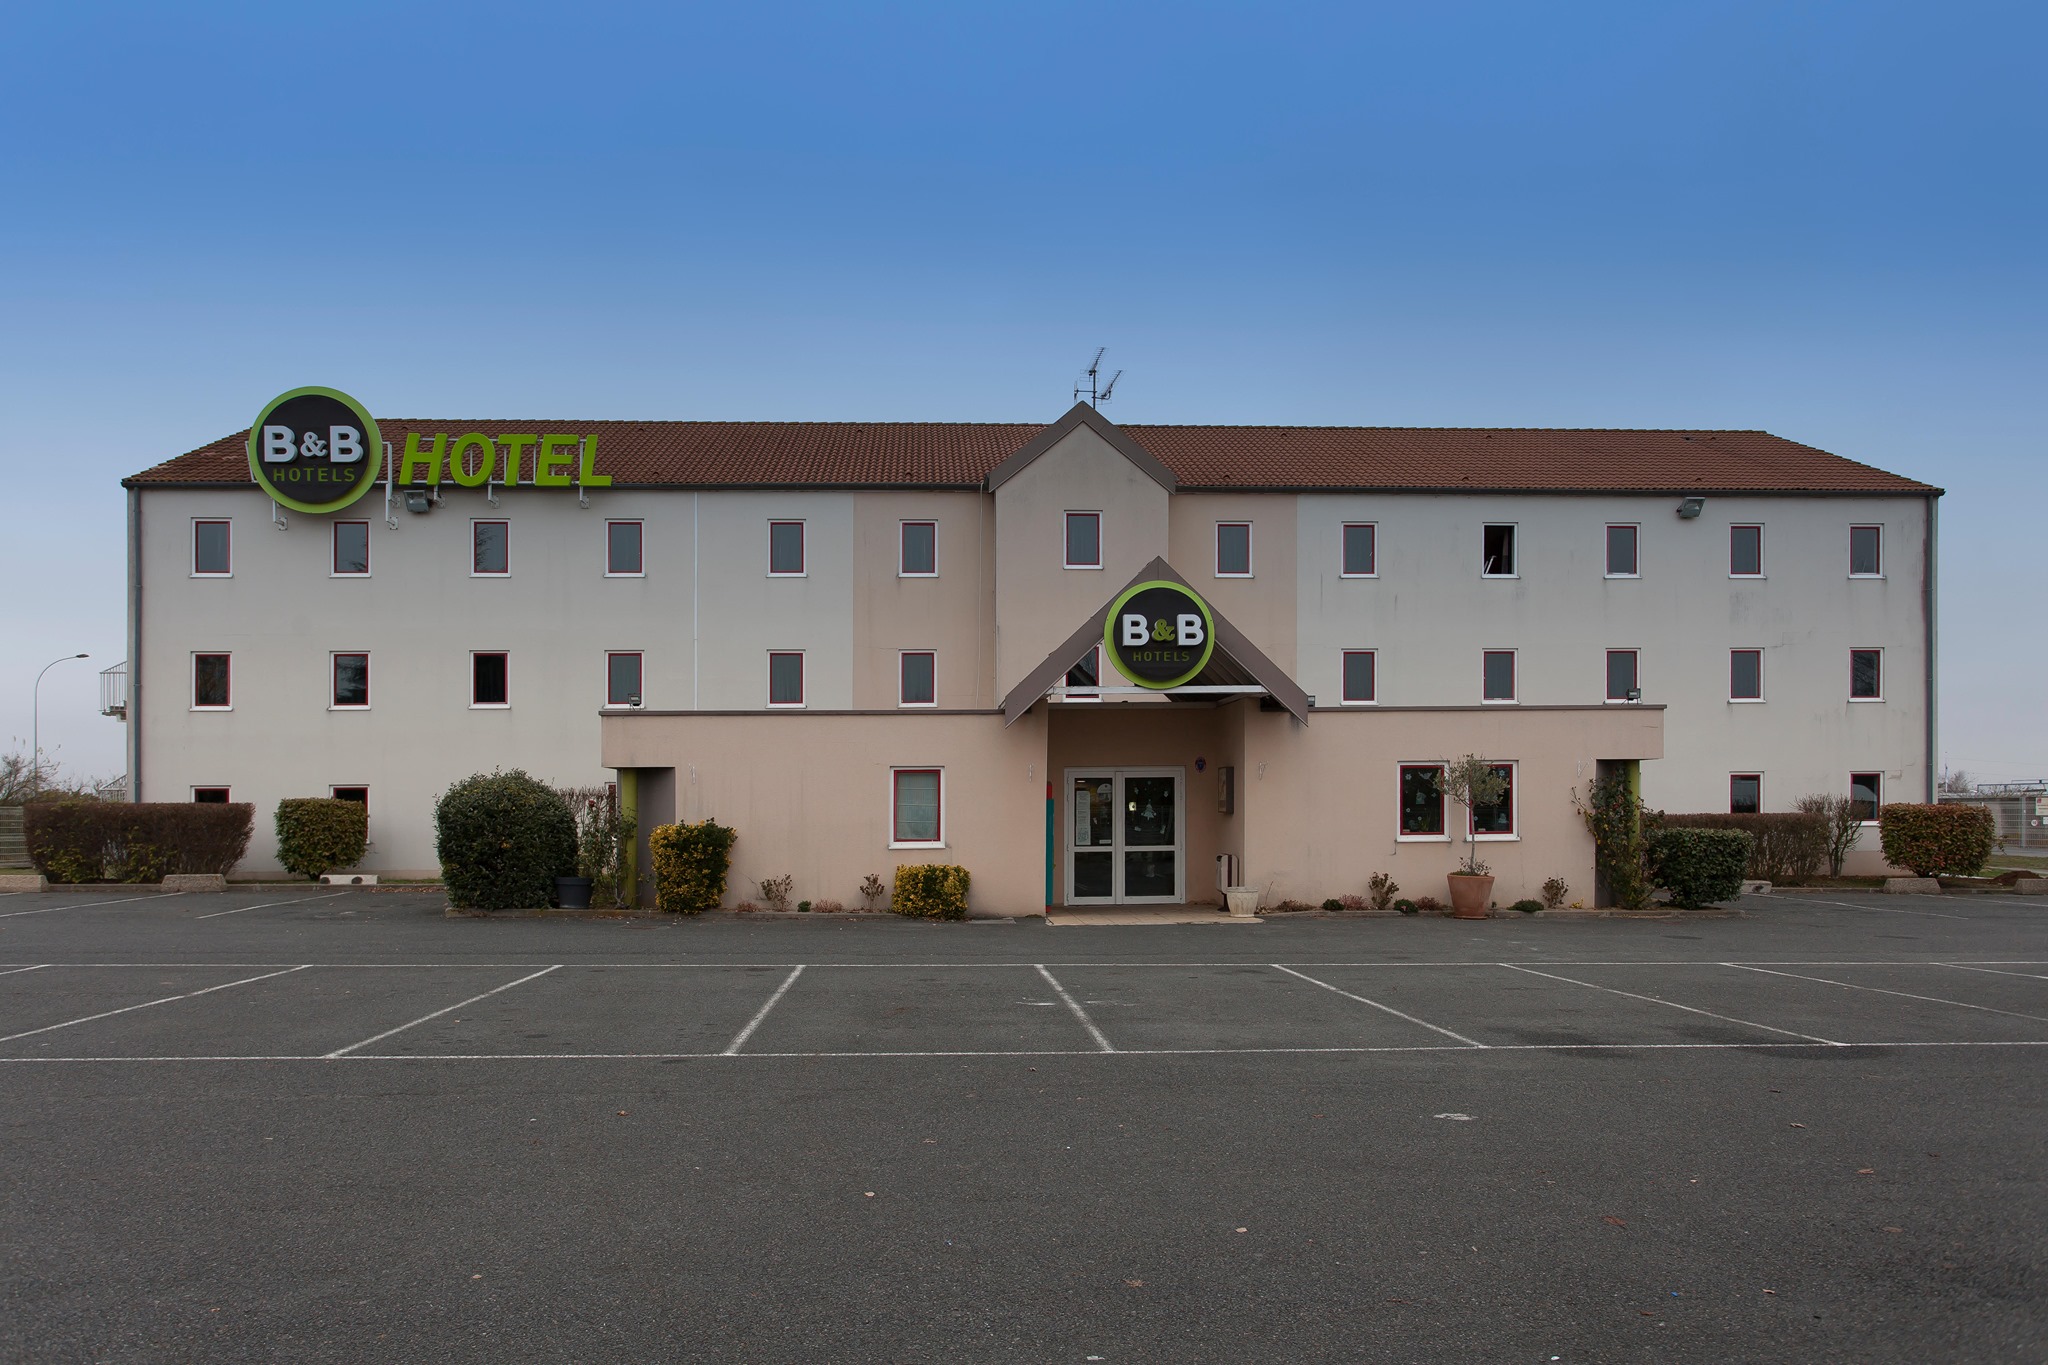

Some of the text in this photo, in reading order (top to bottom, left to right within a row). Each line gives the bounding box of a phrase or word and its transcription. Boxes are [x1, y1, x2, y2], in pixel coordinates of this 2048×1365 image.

[263, 425, 363, 463] B&B
[398, 432, 613, 487] HOTEL
[272, 467, 356, 483] HOTELS
[1122, 613, 1205, 647] B&B
[1132, 651, 1191, 662] HOTELS
